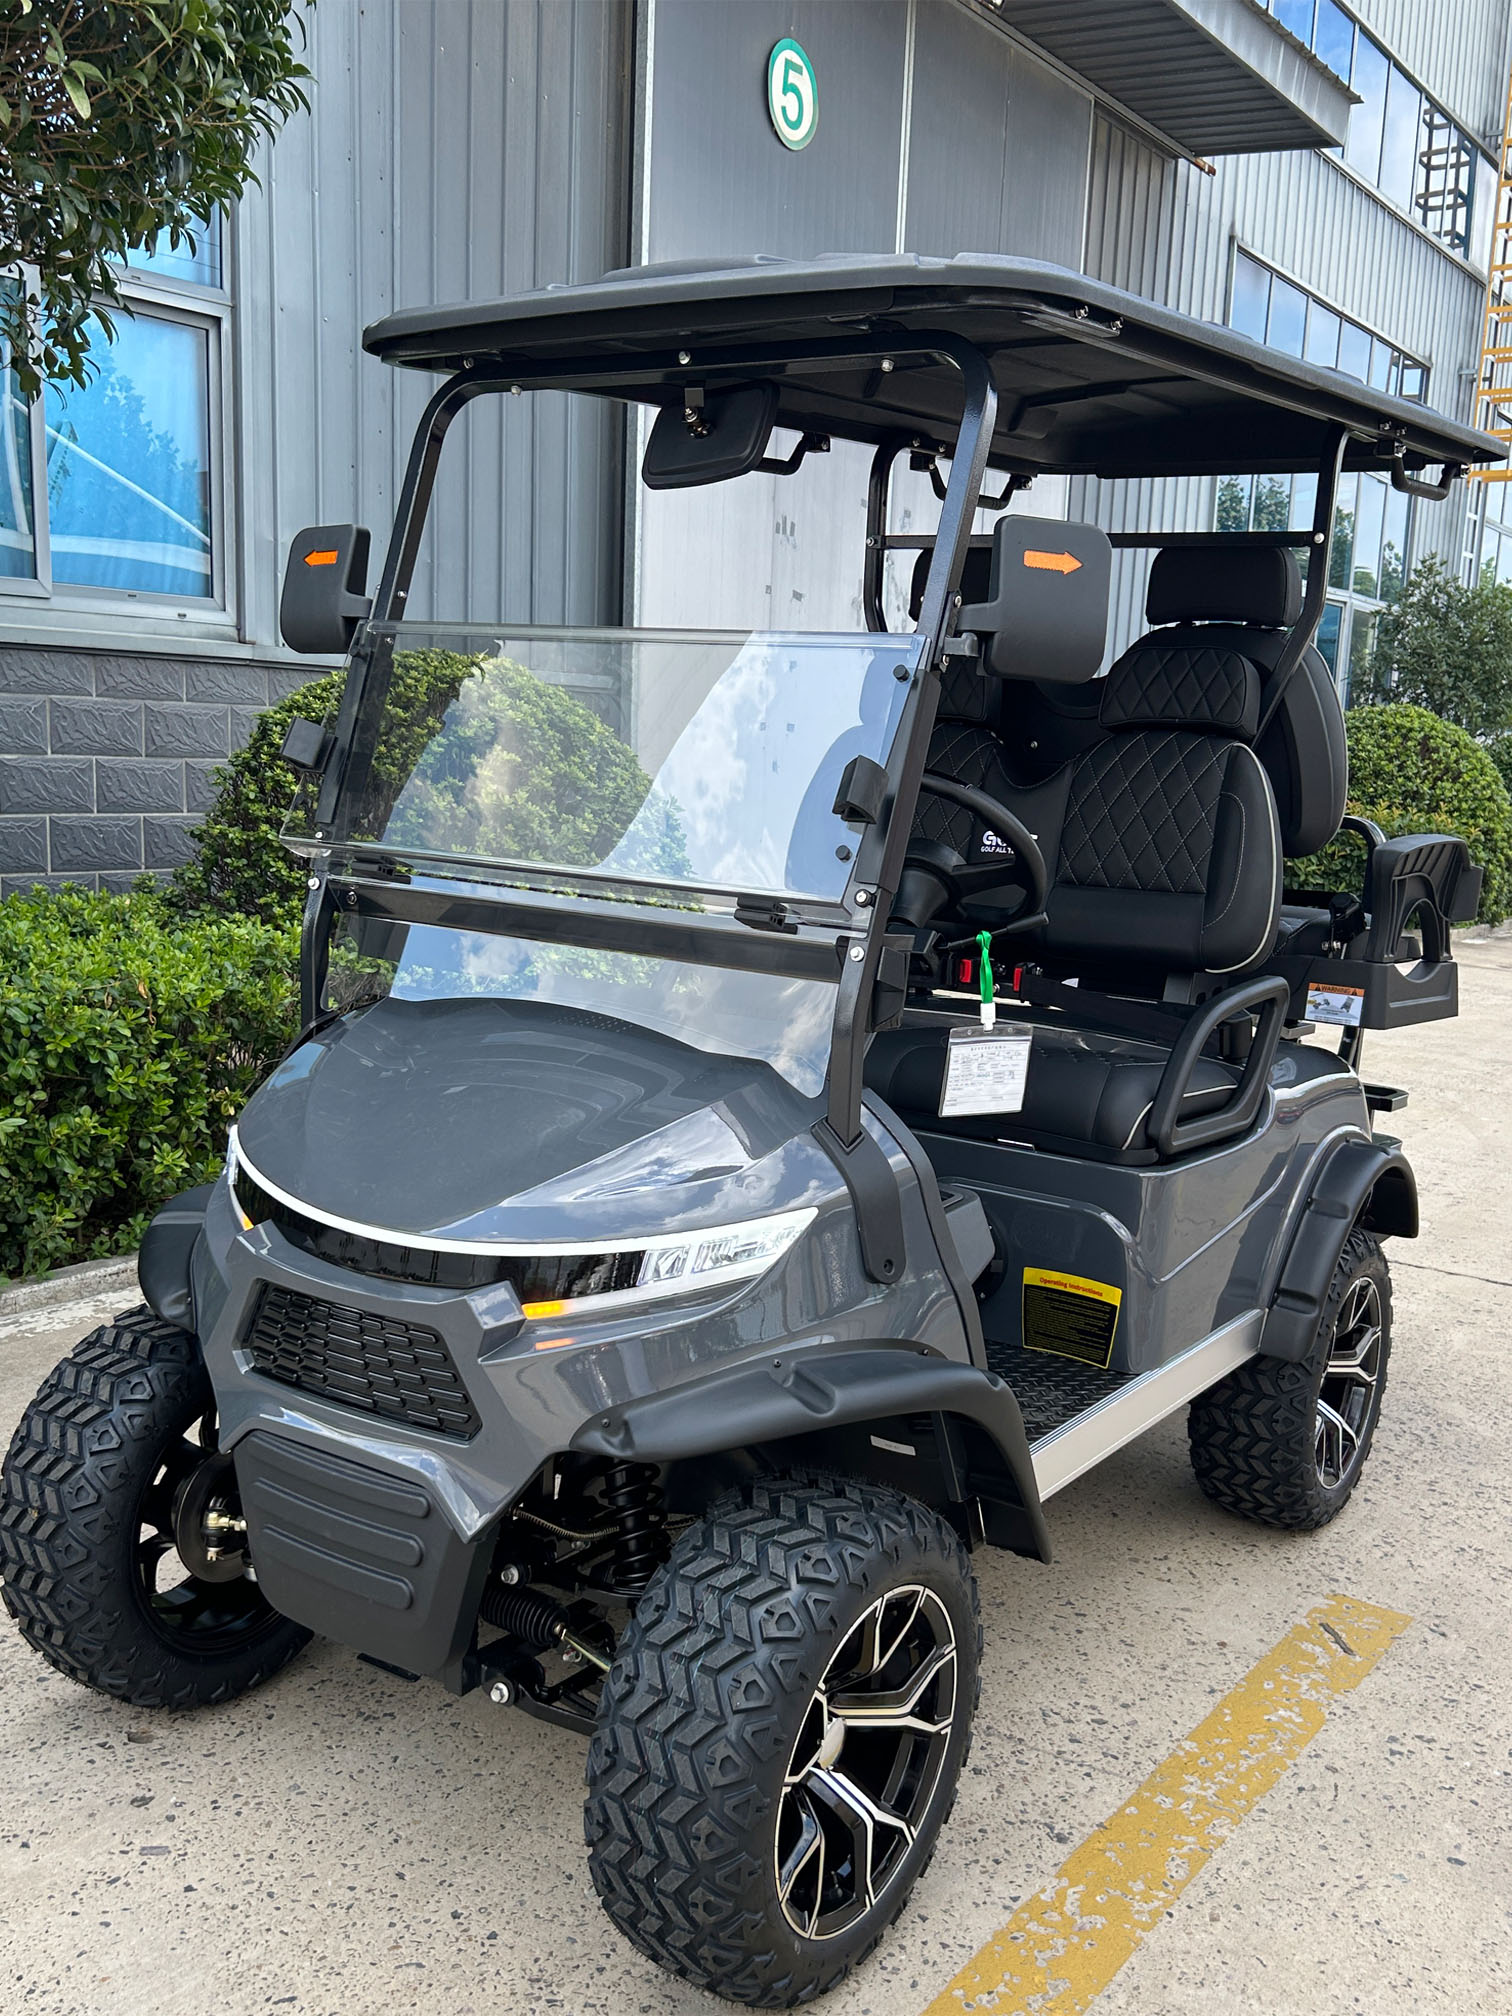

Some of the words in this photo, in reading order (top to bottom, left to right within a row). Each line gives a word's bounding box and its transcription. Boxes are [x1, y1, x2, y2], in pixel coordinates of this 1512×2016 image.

[781, 57, 804, 131] 5
[995, 846, 1007, 854] ALL
[1321, 984, 1352, 994] WARNING
[1040, 1277, 1068, 1289] Operating
[1069, 1282, 1103, 1297] Instructions
